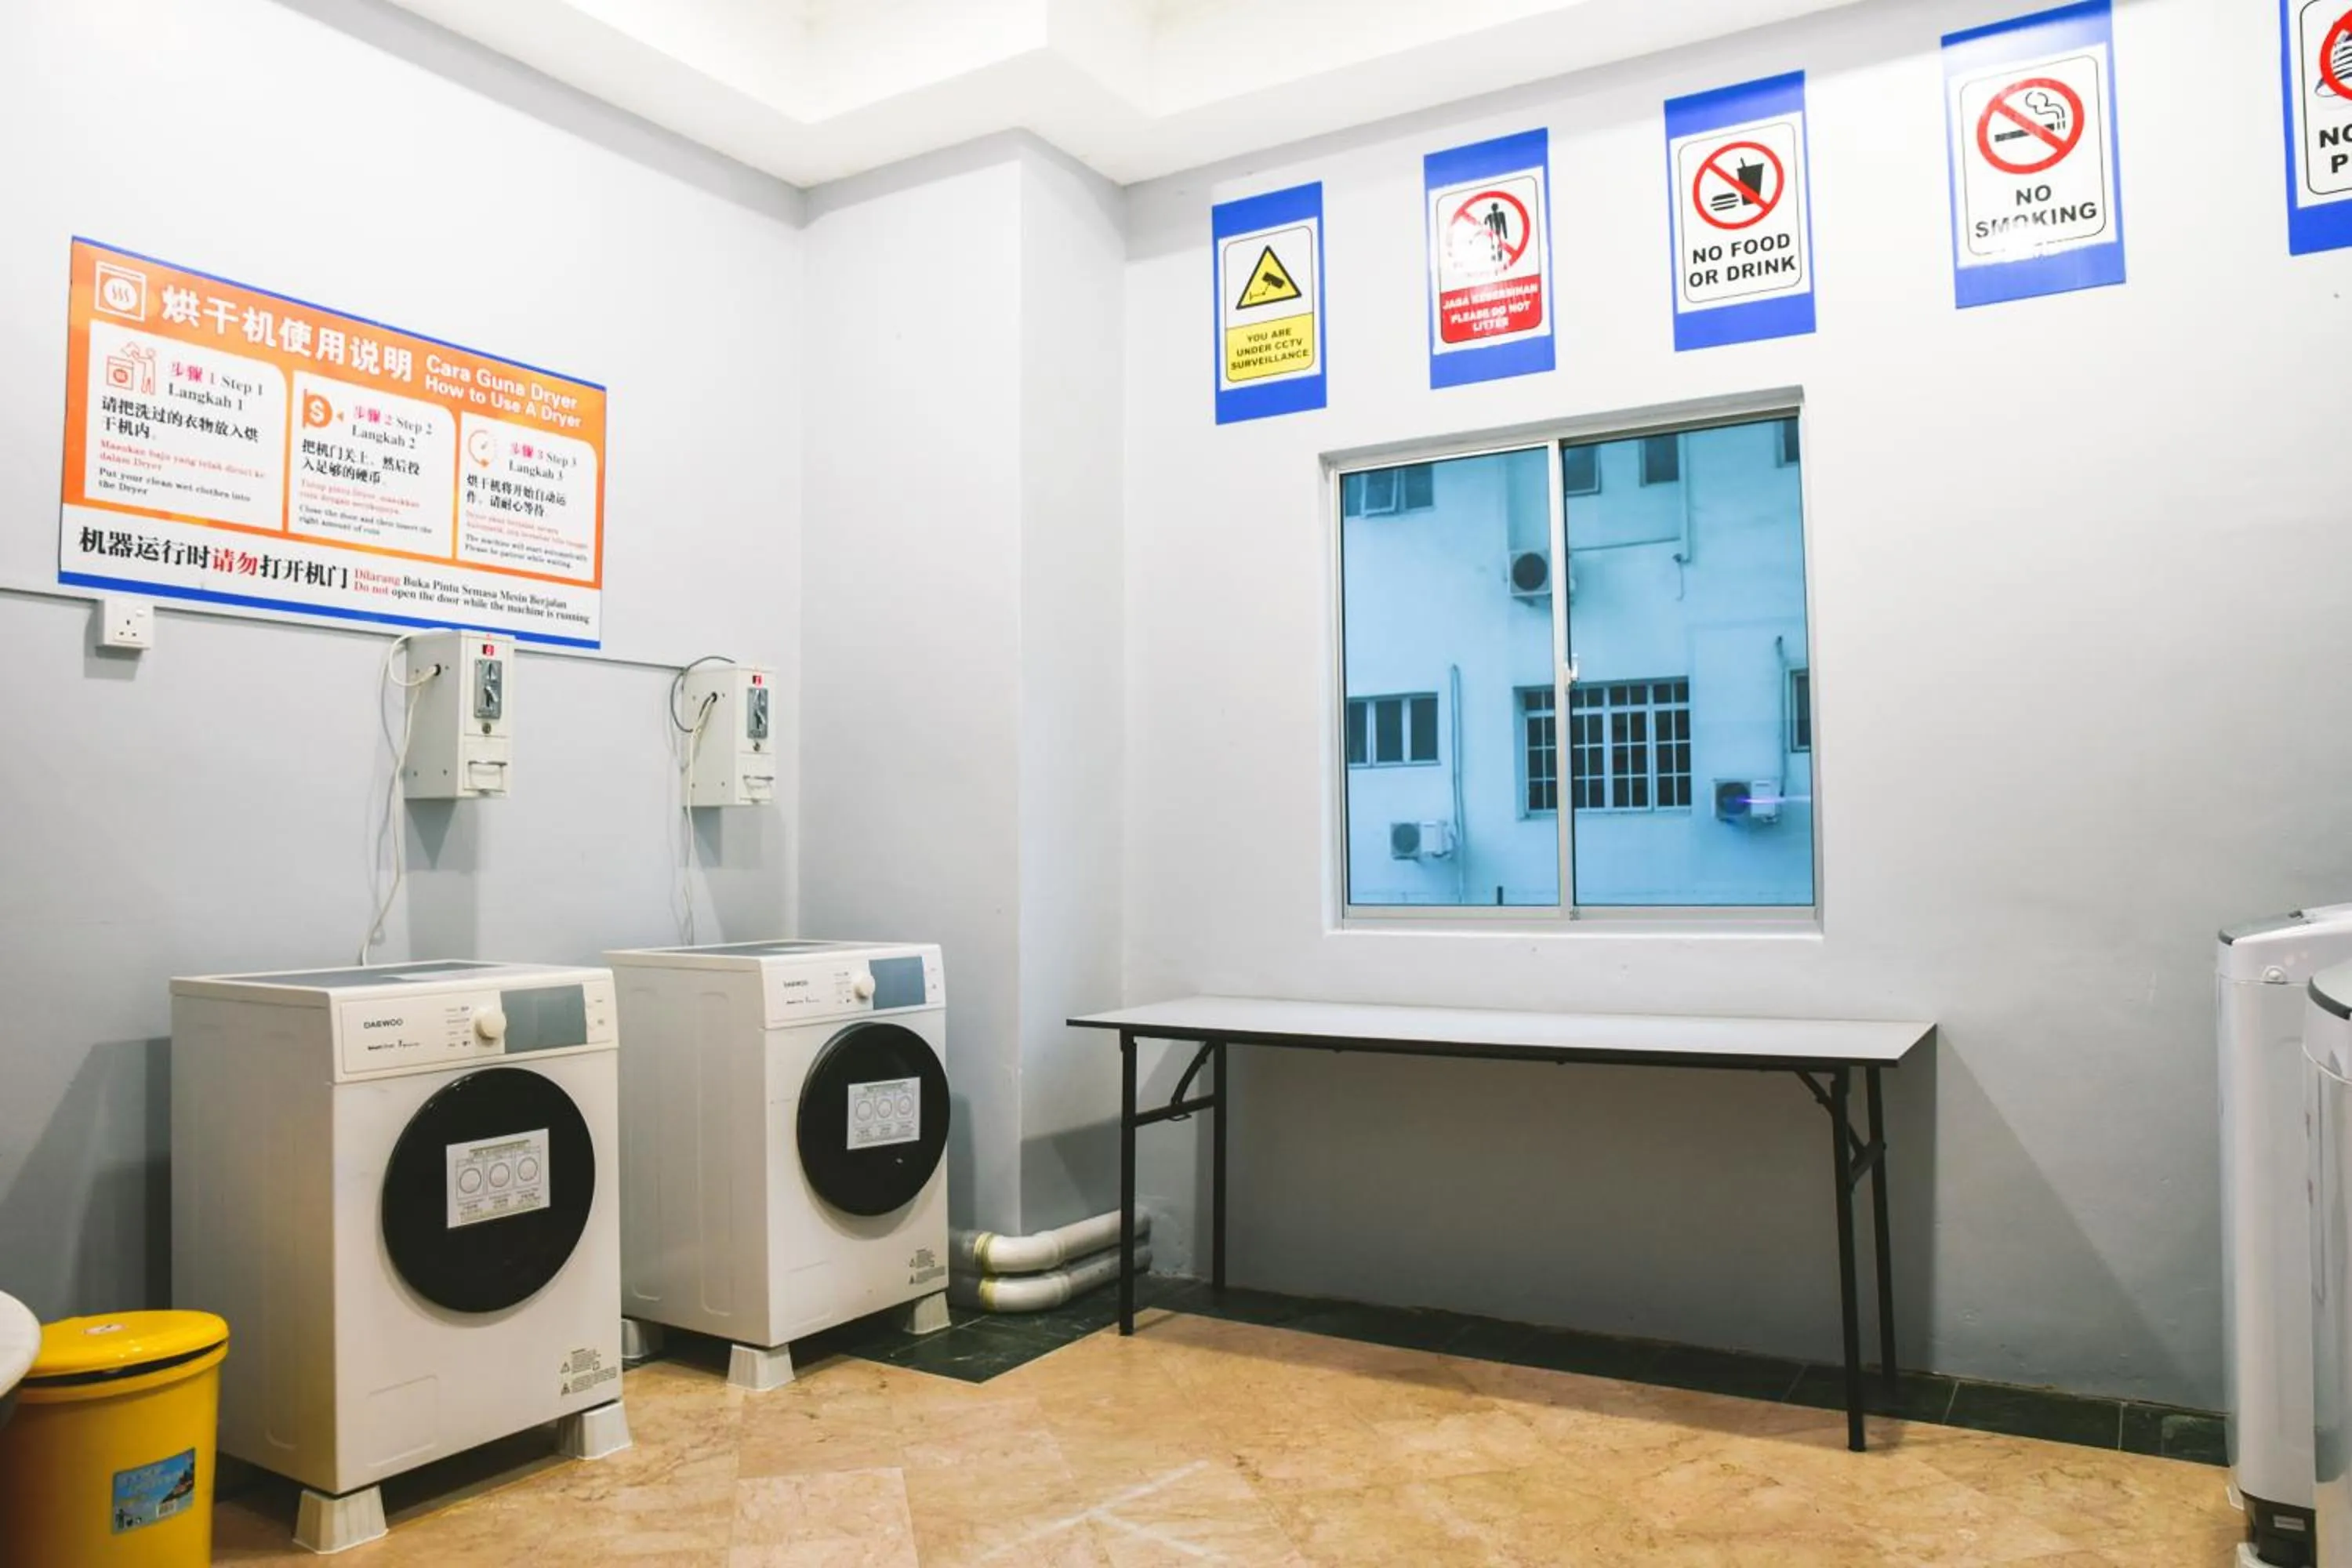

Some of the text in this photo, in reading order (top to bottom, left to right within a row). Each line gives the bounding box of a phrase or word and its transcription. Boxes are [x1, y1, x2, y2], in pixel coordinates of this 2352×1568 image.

[2016, 184, 2052, 206] NO
[1692, 233, 1791, 264] NO FOOD
[1689, 255, 1796, 288] OR DRINK
[1443, 296, 1470, 310] JAGA
[1450, 300, 1530, 324] PLEASE DO NOT
[162, 285, 412, 382] 烘干机使用说明
[1472, 316, 1509, 332] LITTER
[1247, 328, 1292, 343] YOU ARE
[1236, 338, 1303, 357] UNDER CCTV
[1231, 349, 1310, 371] SURVEILLANCE
[222, 376, 252, 397] Step
[257, 383, 263, 397] 1
[426, 354, 578, 410] Cara Guna Dryer
[168, 383, 244, 412] Langkah 1
[425, 376, 582, 428] How to Use A Dryer
[101, 395, 260, 444] 请把洗过的衣物放入烘
[396, 416, 423, 435] Step
[426, 423, 433, 435] 2
[351, 424, 416, 449] Langkah 2
[173, 454, 197, 468] yang
[509, 459, 564, 481] Langkah 3
[546, 452, 568, 468] Step
[98, 479, 148, 496] the Dryer
[99, 466, 118, 478] Put
[120, 472, 143, 485] your
[146, 476, 173, 489] clean
[175, 481, 194, 492] wet
[195, 485, 230, 500] clothes
[360, 515, 375, 525] and
[79, 526, 348, 590] 机器运行时请勿打开机门
[354, 568, 567, 609] Dilarang Buka Pintu Semasa Mesin Berjalan
[354, 581, 590, 625] Do not open the door while the machine is running
[363, 1018, 405, 1029] DAEWOO
